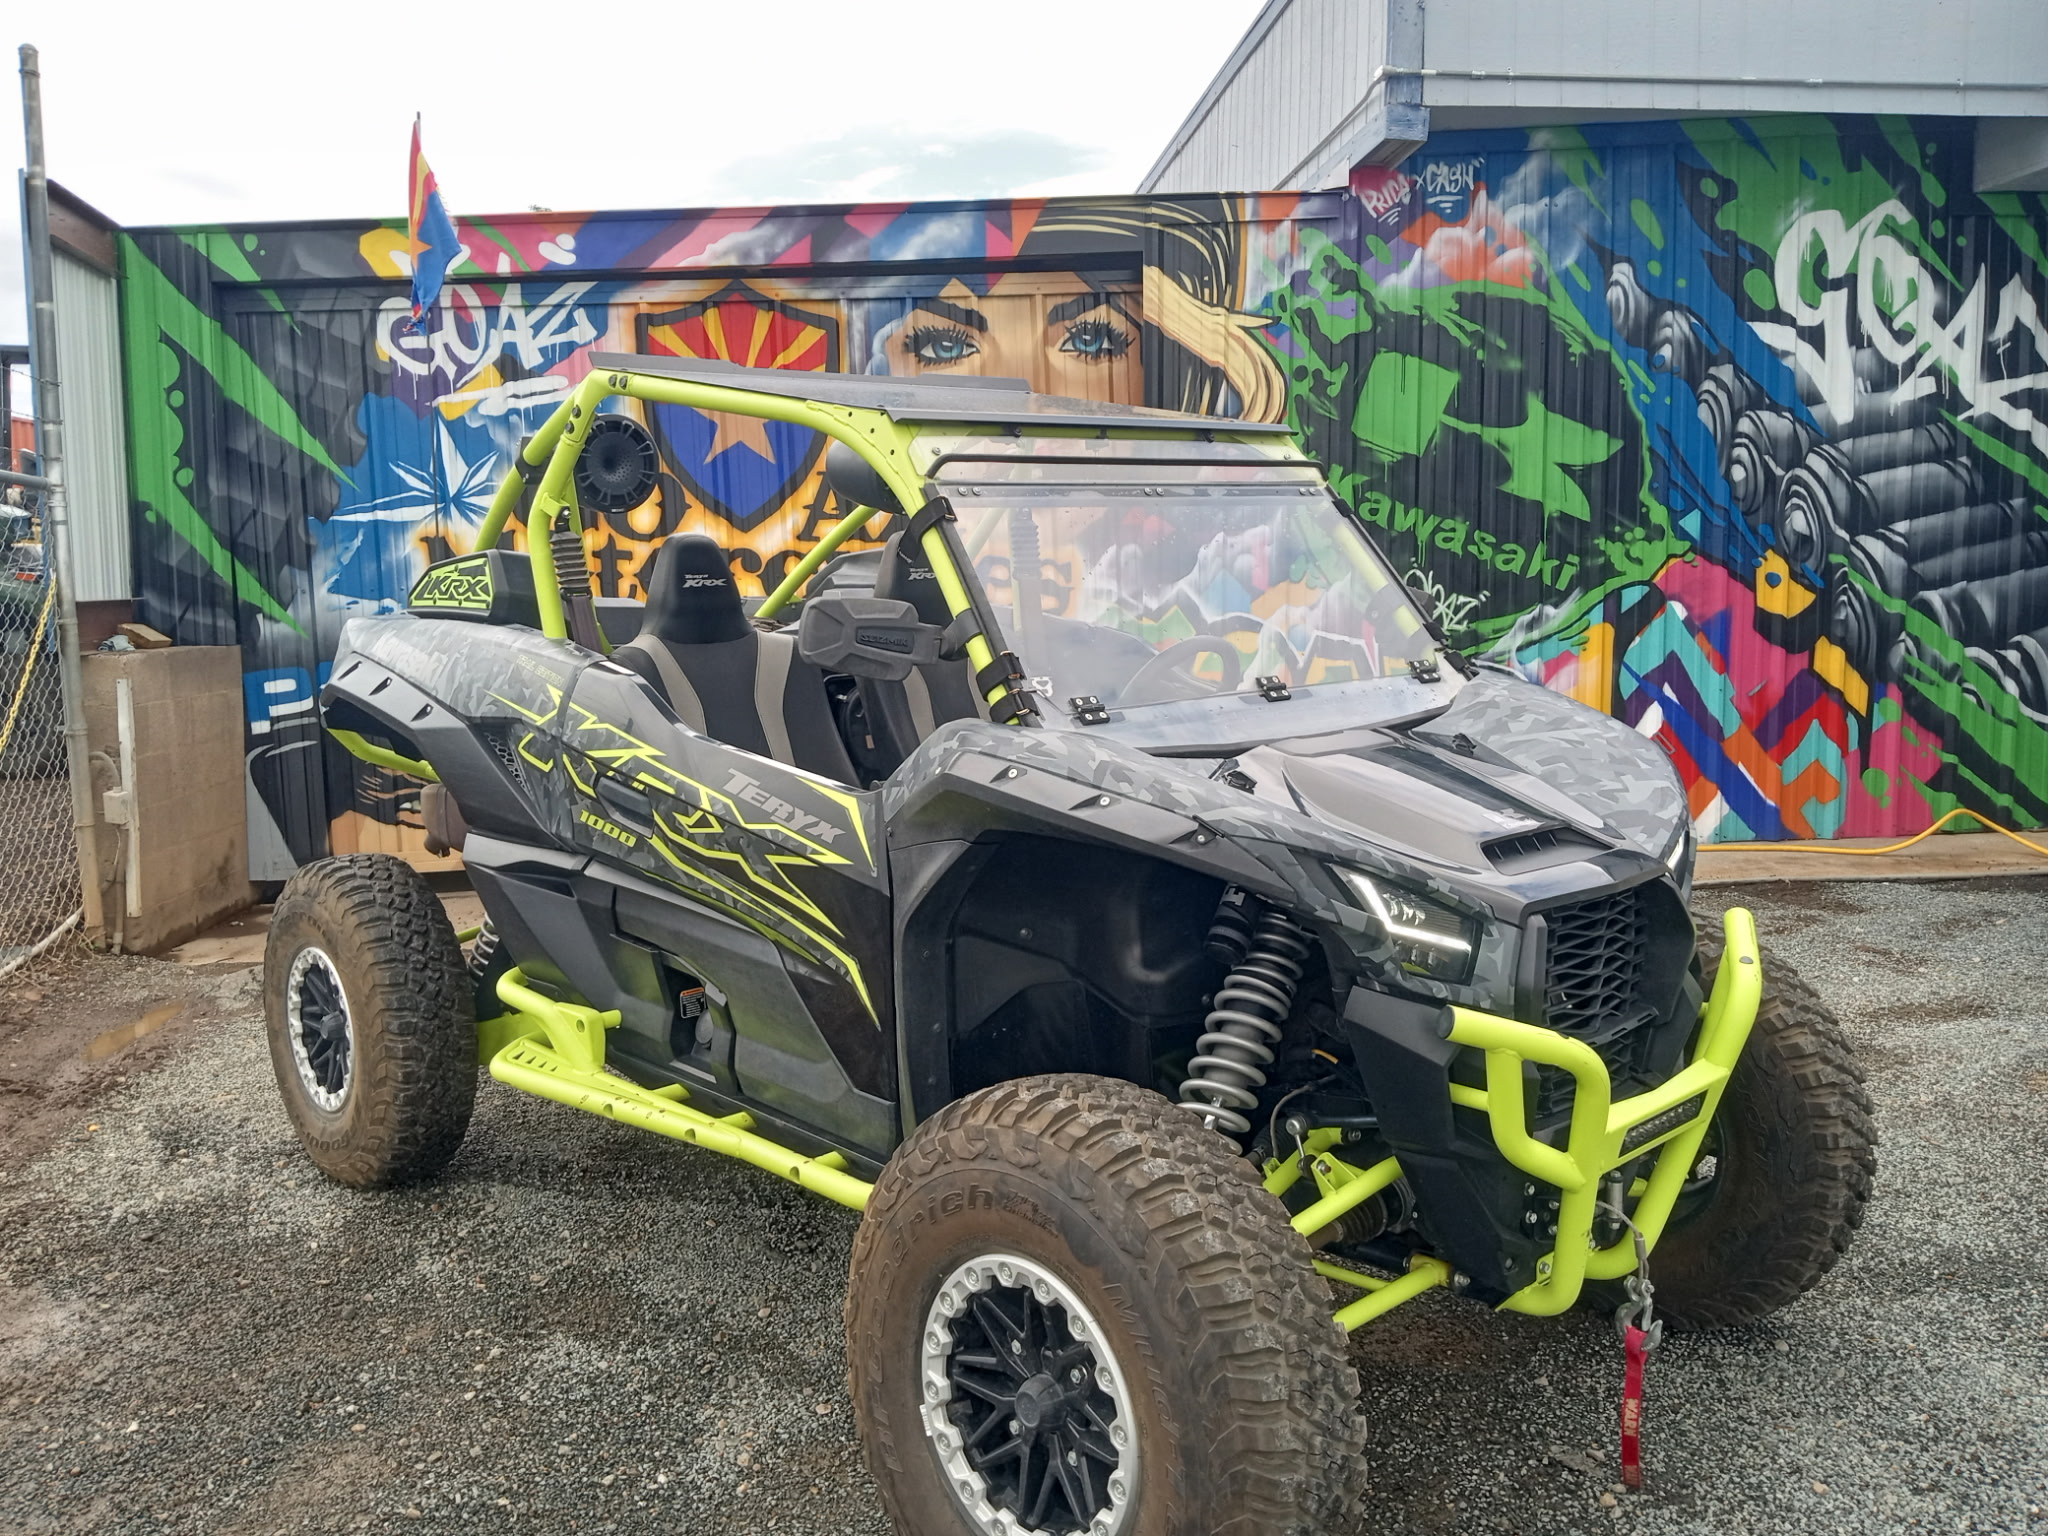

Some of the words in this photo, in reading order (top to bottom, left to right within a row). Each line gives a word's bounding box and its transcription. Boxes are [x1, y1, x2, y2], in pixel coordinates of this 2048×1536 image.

[1327, 463, 1581, 592] Kawasaki
[425, 571, 487, 600] KRX
[682, 578, 728, 588] KRX
[859, 633, 910, 648] SEIZMIK
[578, 809, 638, 848] 1000
[1623, 1398, 1638, 1437] WARN
